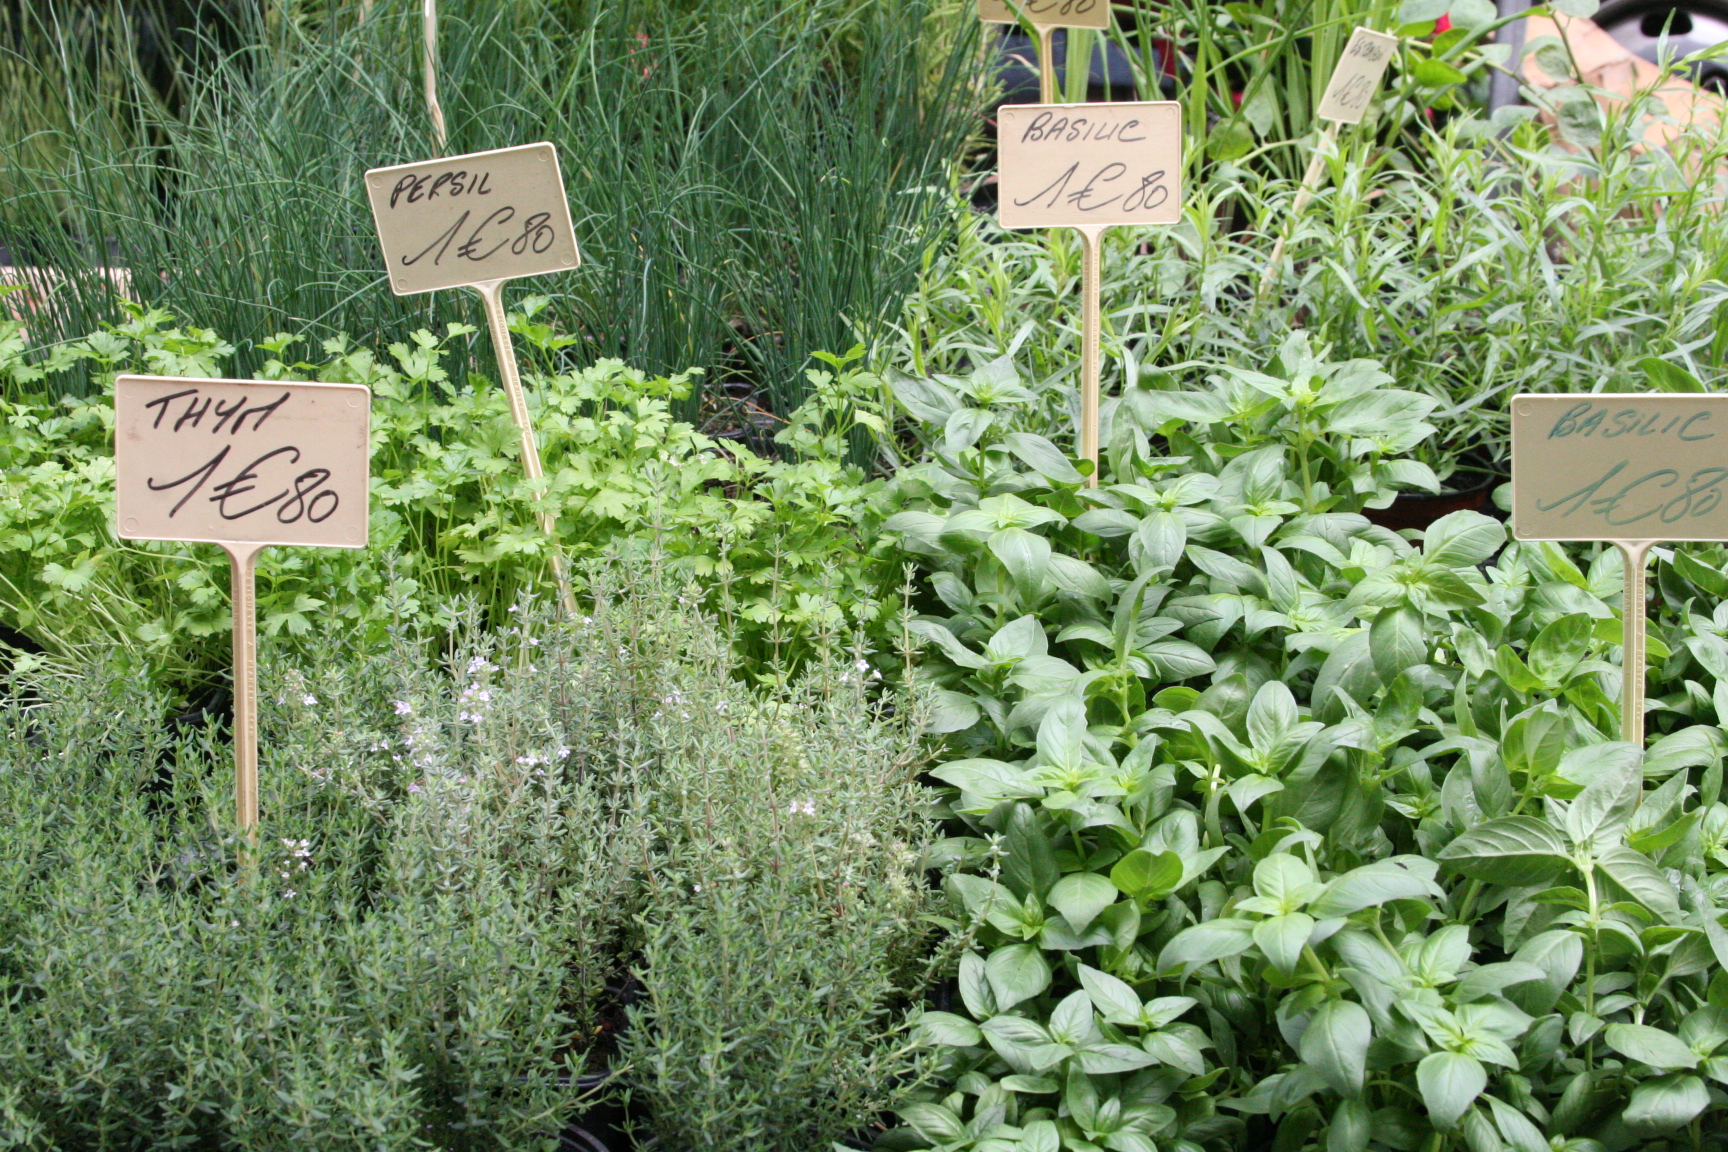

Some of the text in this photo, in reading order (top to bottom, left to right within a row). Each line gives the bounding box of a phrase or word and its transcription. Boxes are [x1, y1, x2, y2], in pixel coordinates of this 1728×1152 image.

[1021, 111, 1147, 144] BASILIC
[389, 170, 492, 209] PERSIL
[1013, 161, 1168, 212] 1€80
[401, 205, 555, 266] 1€80
[145, 388, 291, 435] THYM
[1547, 401, 1715, 441] BASILIC
[147, 444, 339, 524] 1€80
[1535, 459, 1728, 526] 1€80
